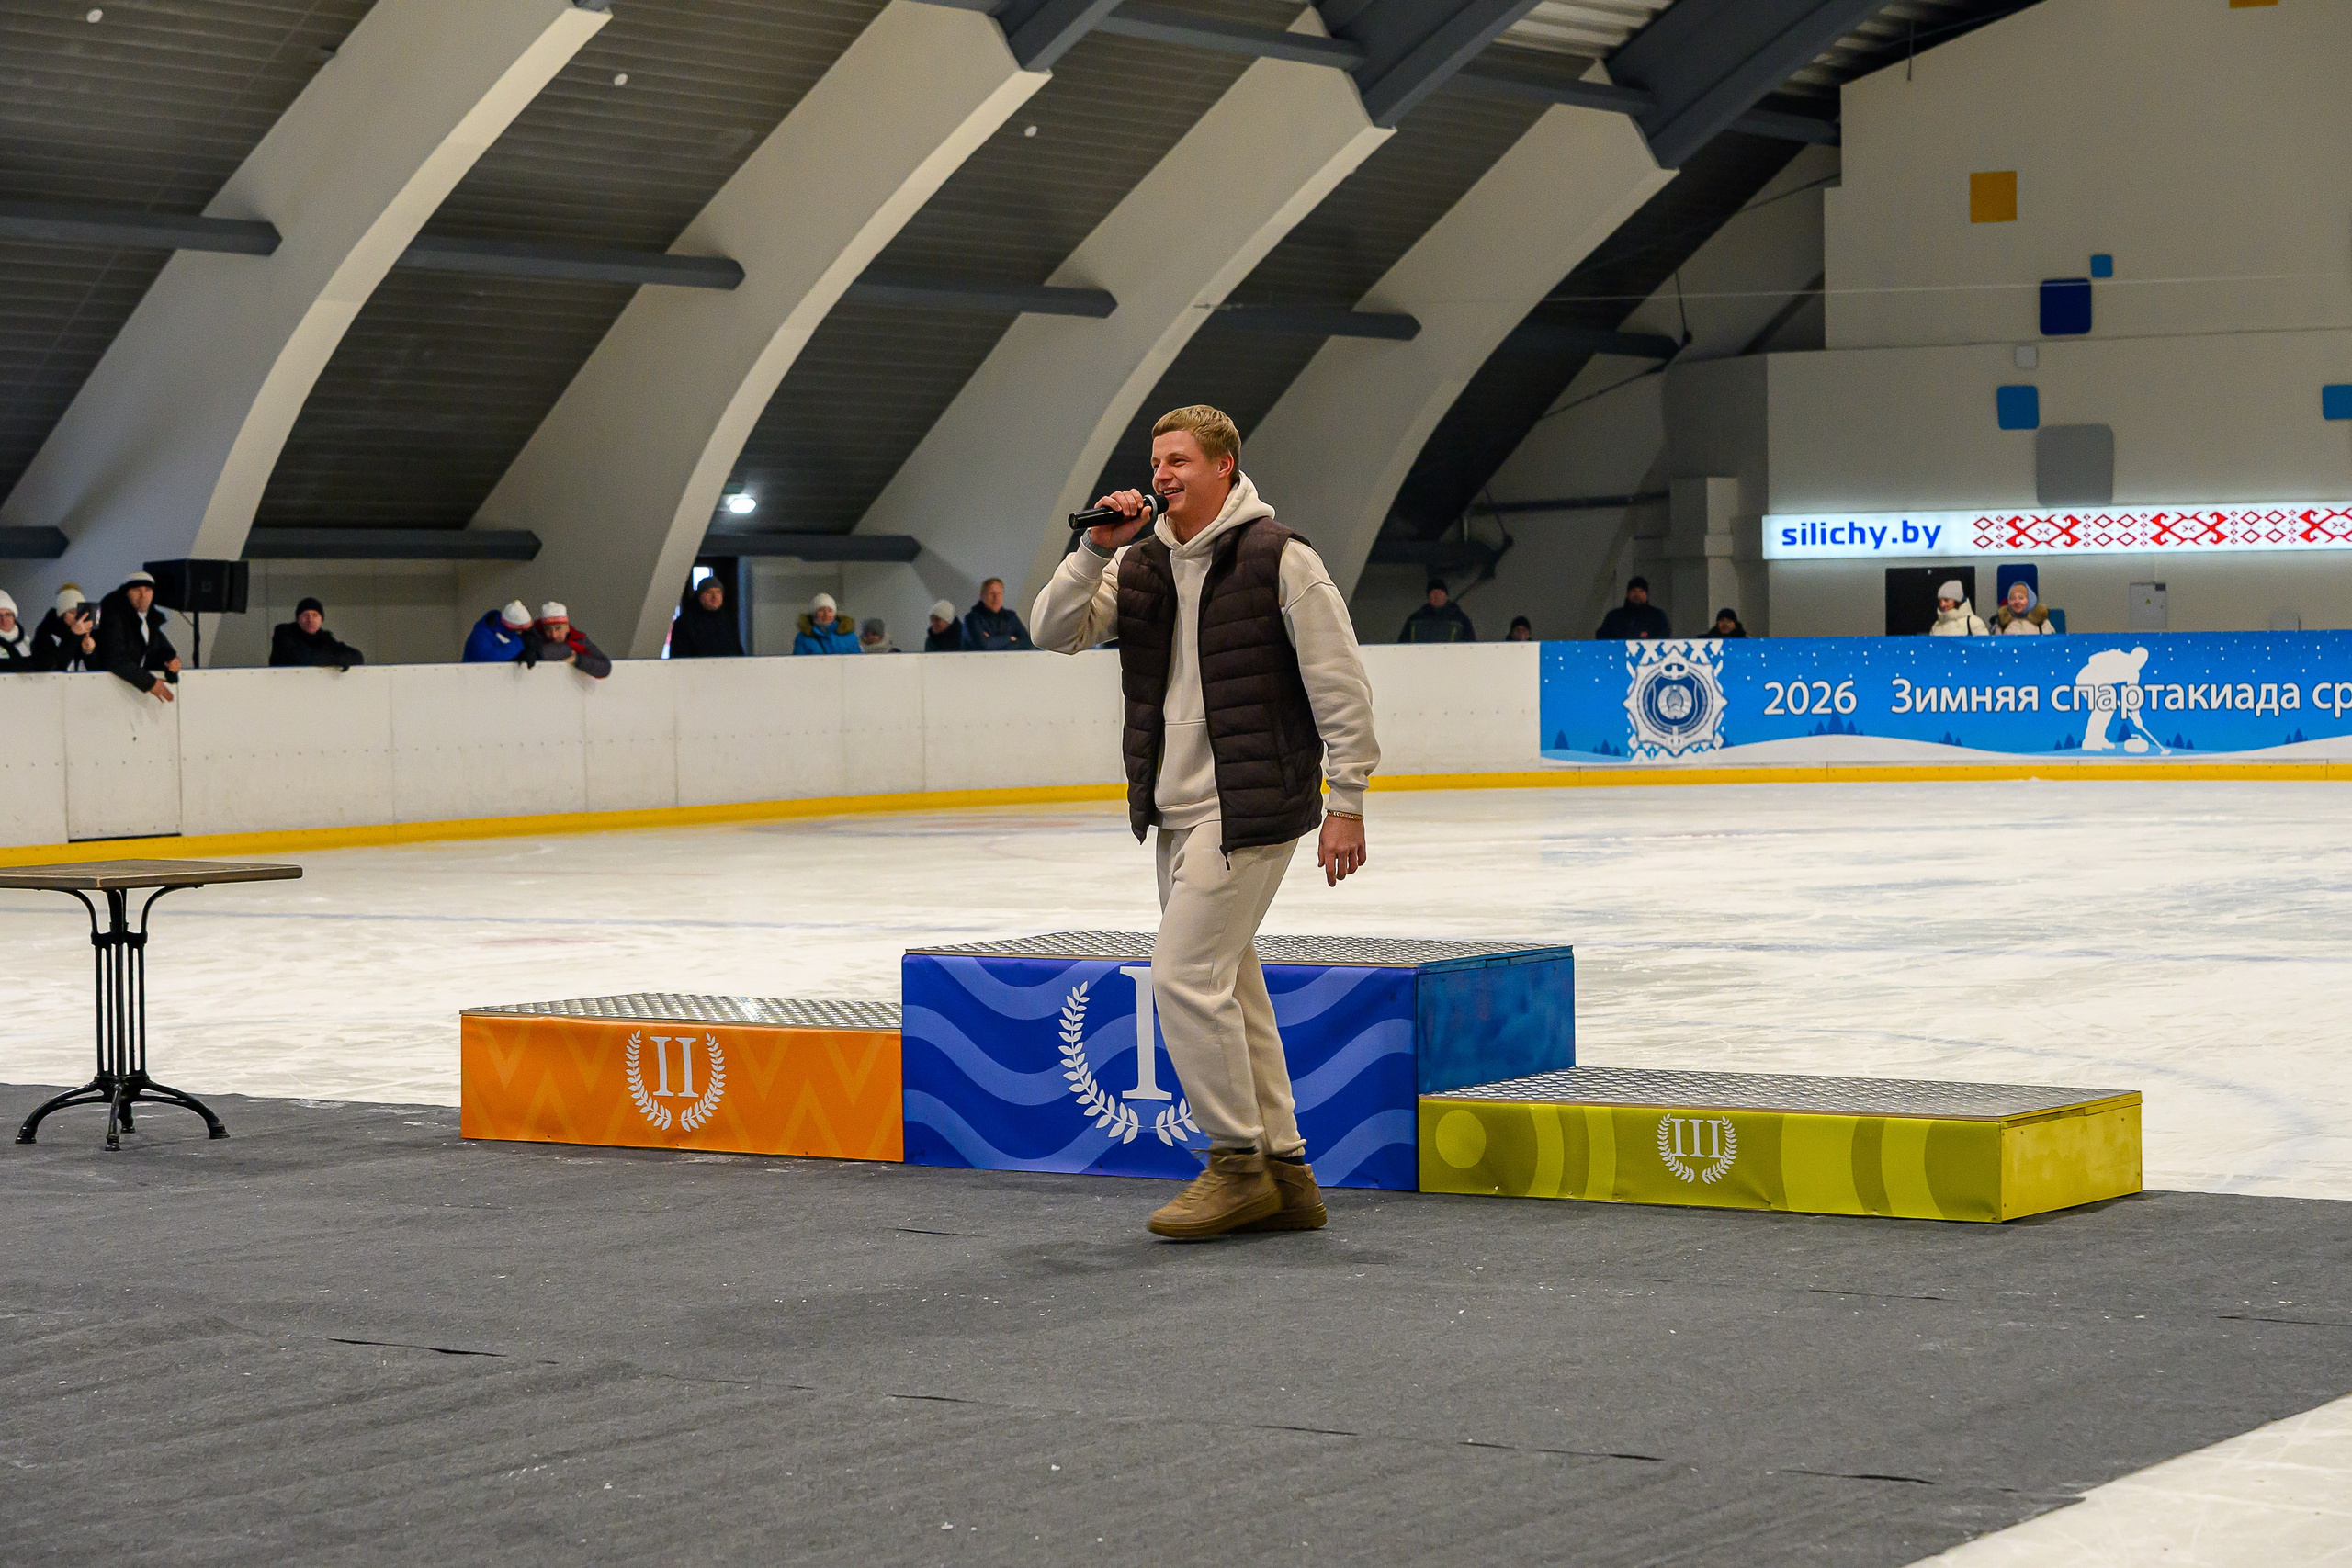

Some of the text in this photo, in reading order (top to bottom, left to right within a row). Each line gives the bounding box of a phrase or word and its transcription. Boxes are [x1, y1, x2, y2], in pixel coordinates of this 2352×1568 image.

[1781, 519, 1942, 550] silichy.by
[1763, 680, 1858, 716] 2026
[1890, 677, 2040, 714] Зимняя
[2050, 682, 2301, 719] спартакиада
[1119, 965, 1172, 1100] I
[650, 1036, 699, 1098] II
[1669, 1118, 1724, 1158] III
